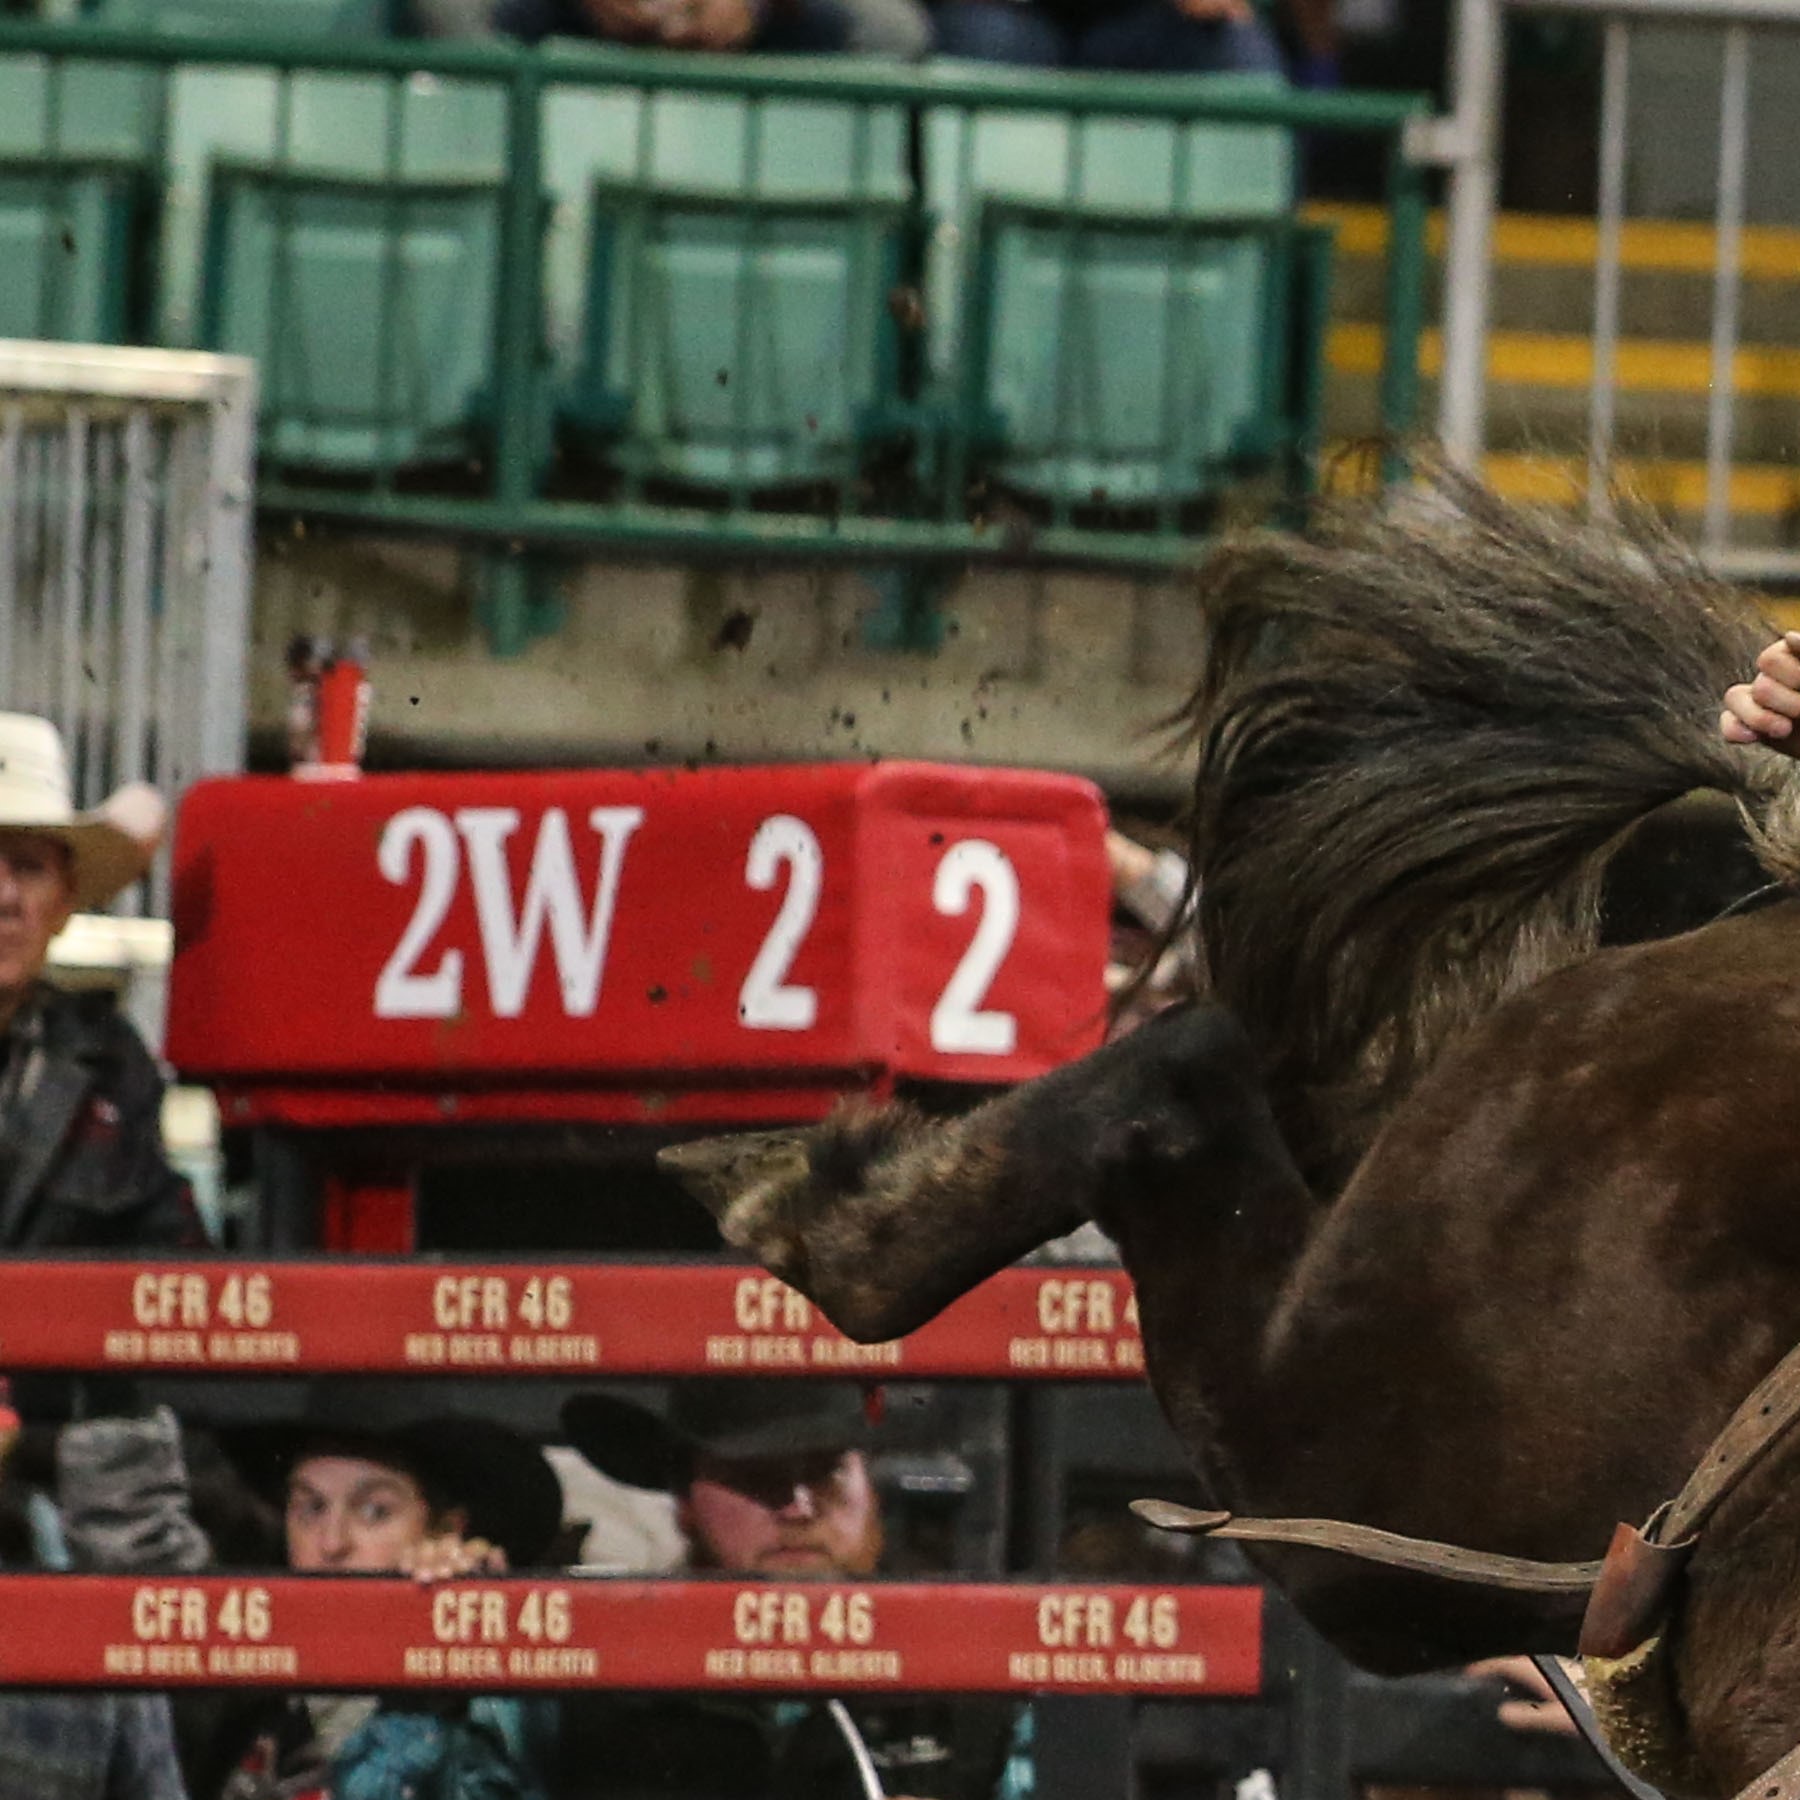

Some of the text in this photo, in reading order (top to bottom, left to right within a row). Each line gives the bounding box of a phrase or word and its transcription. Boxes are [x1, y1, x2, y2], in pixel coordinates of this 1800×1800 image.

[374, 805, 824, 1029] 2W 2
[929, 838, 1020, 1055] 2
[133, 1273, 273, 1328] CFR 46
[433, 1275, 573, 1330] CFR 46
[1037, 1279, 1117, 1334] CFR
[132, 1586, 273, 1641] CFR 46
[432, 1589, 574, 1643] CFR 46
[733, 1591, 875, 1645] CFR 46
[1037, 1594, 1180, 1649] CFR 46
